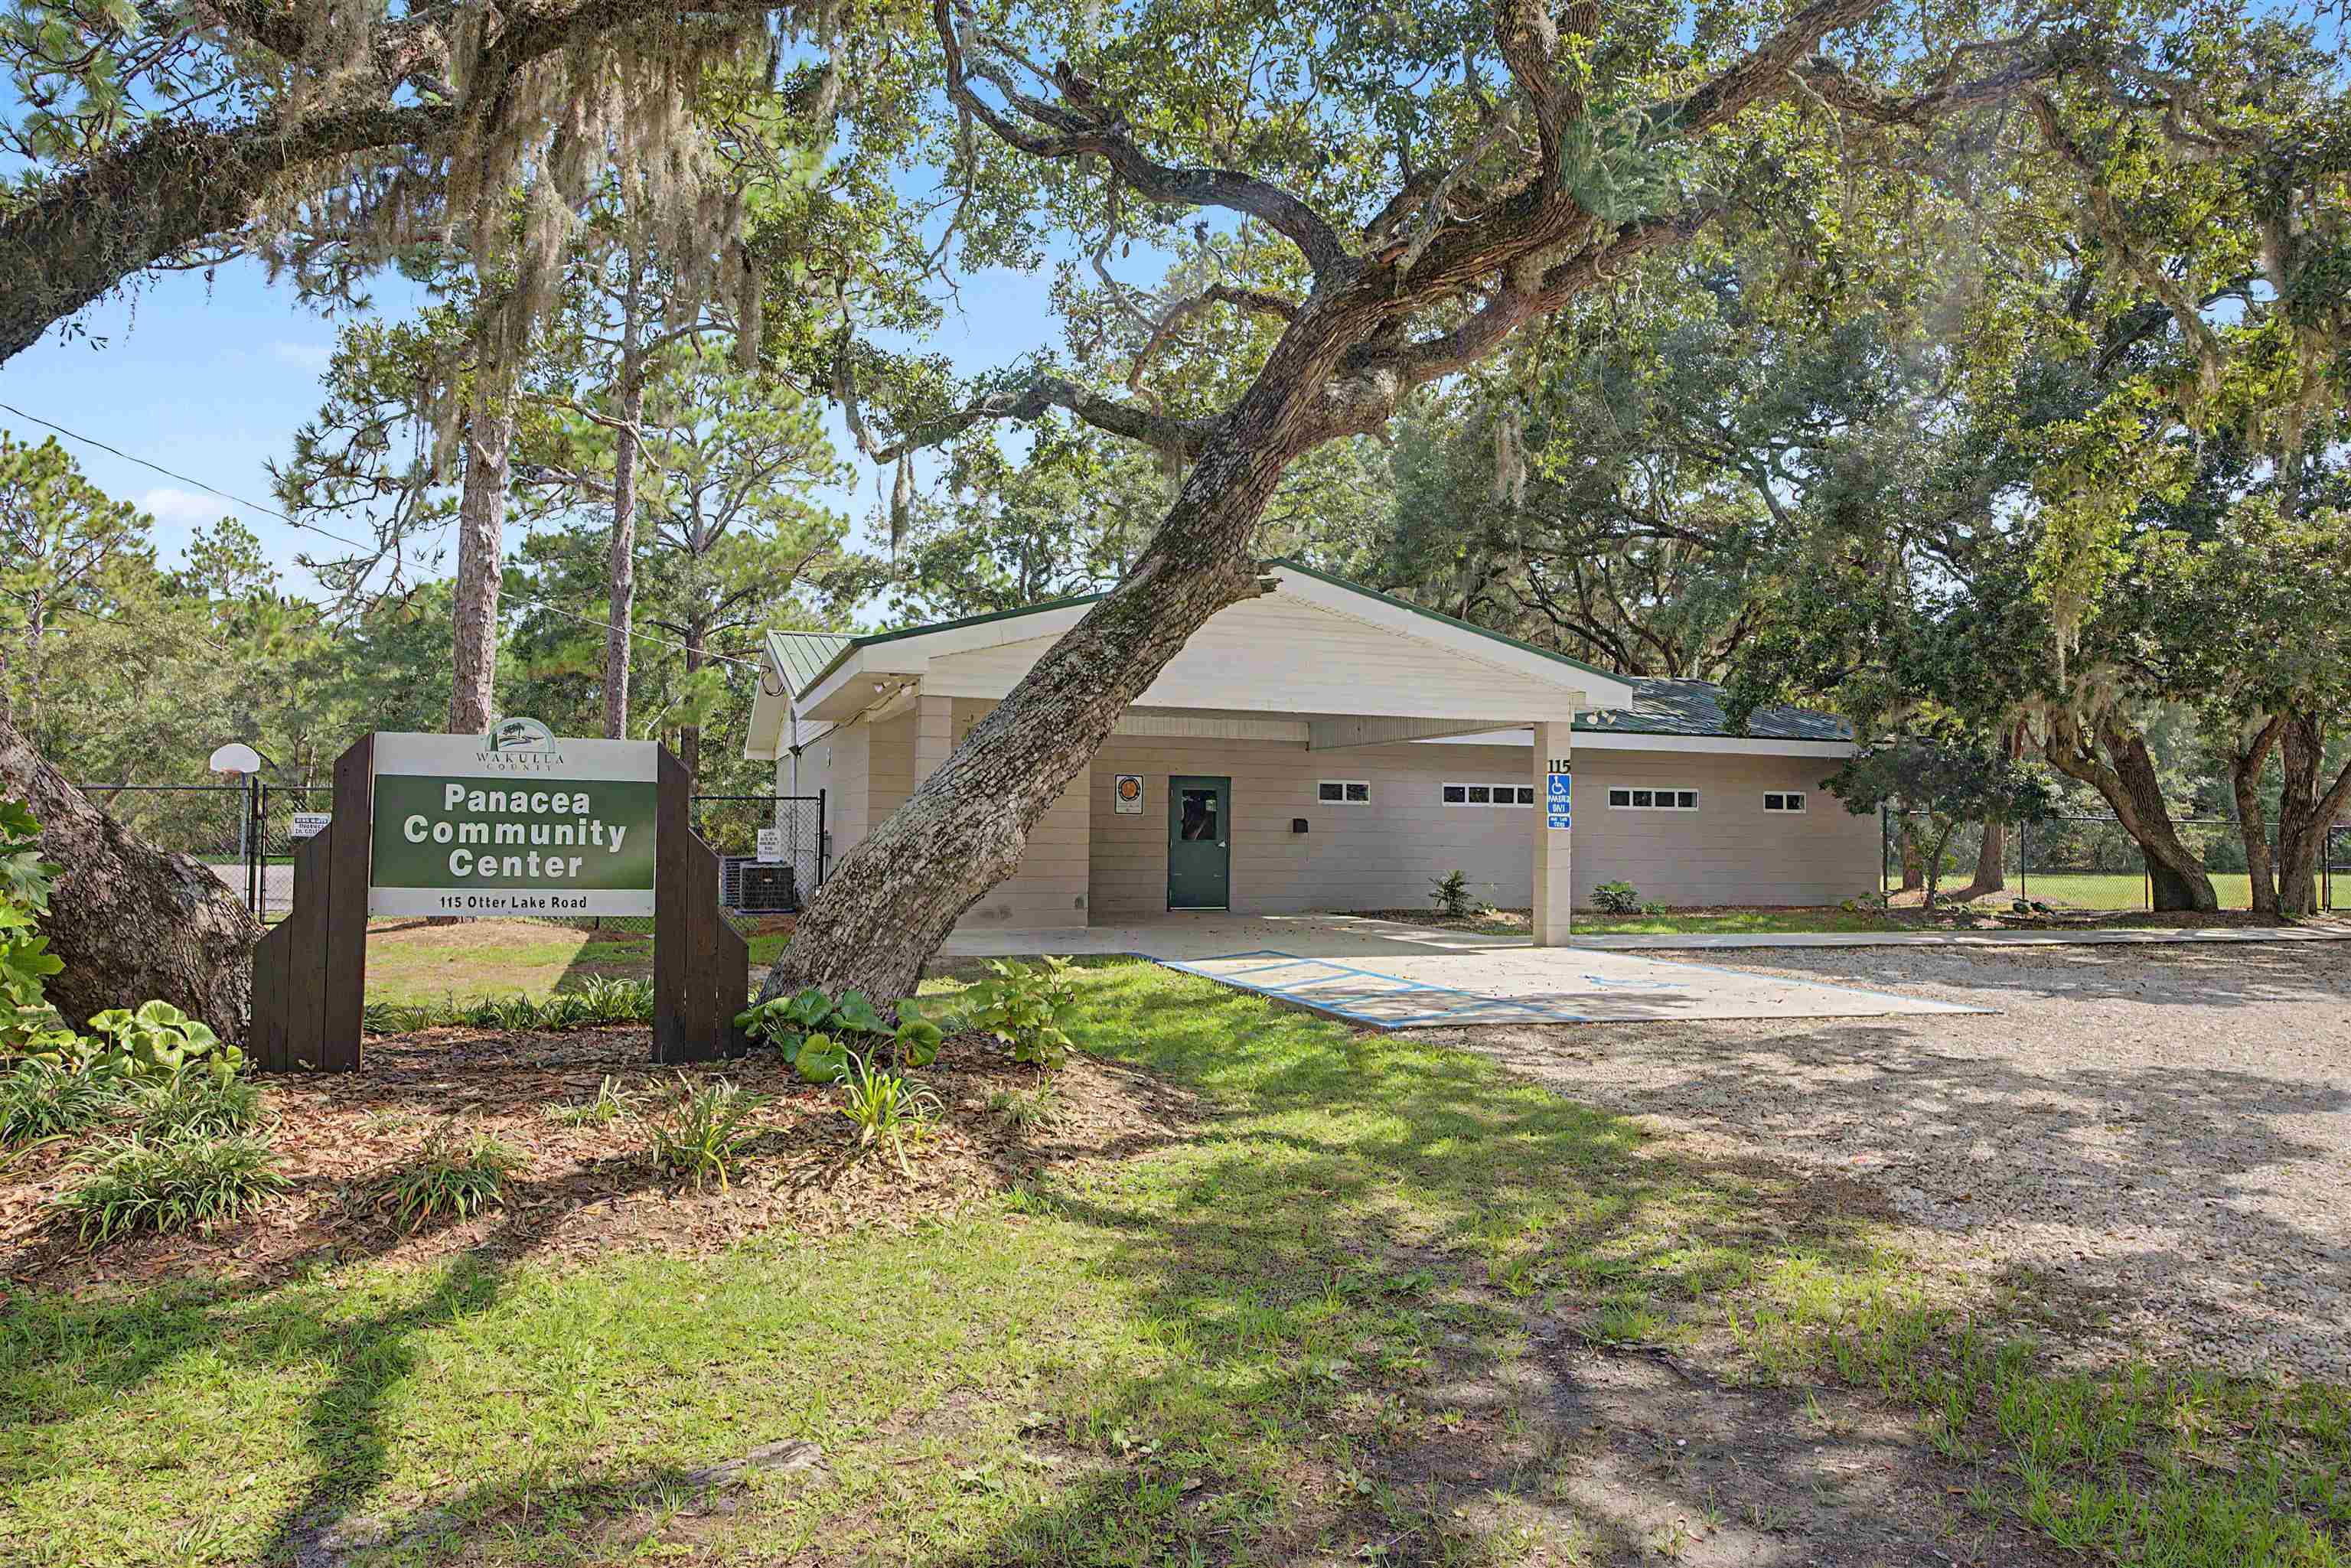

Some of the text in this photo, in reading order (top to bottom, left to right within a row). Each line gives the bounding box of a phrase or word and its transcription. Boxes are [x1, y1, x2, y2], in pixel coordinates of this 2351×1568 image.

[476, 753, 563, 764] WAKULLA
[1548, 760, 1571, 774] 115
[445, 784, 590, 814] Panacea
[404, 815, 627, 852] Community
[448, 849, 582, 878] Center
[440, 896, 586, 908] 115 Otter Lake Road
